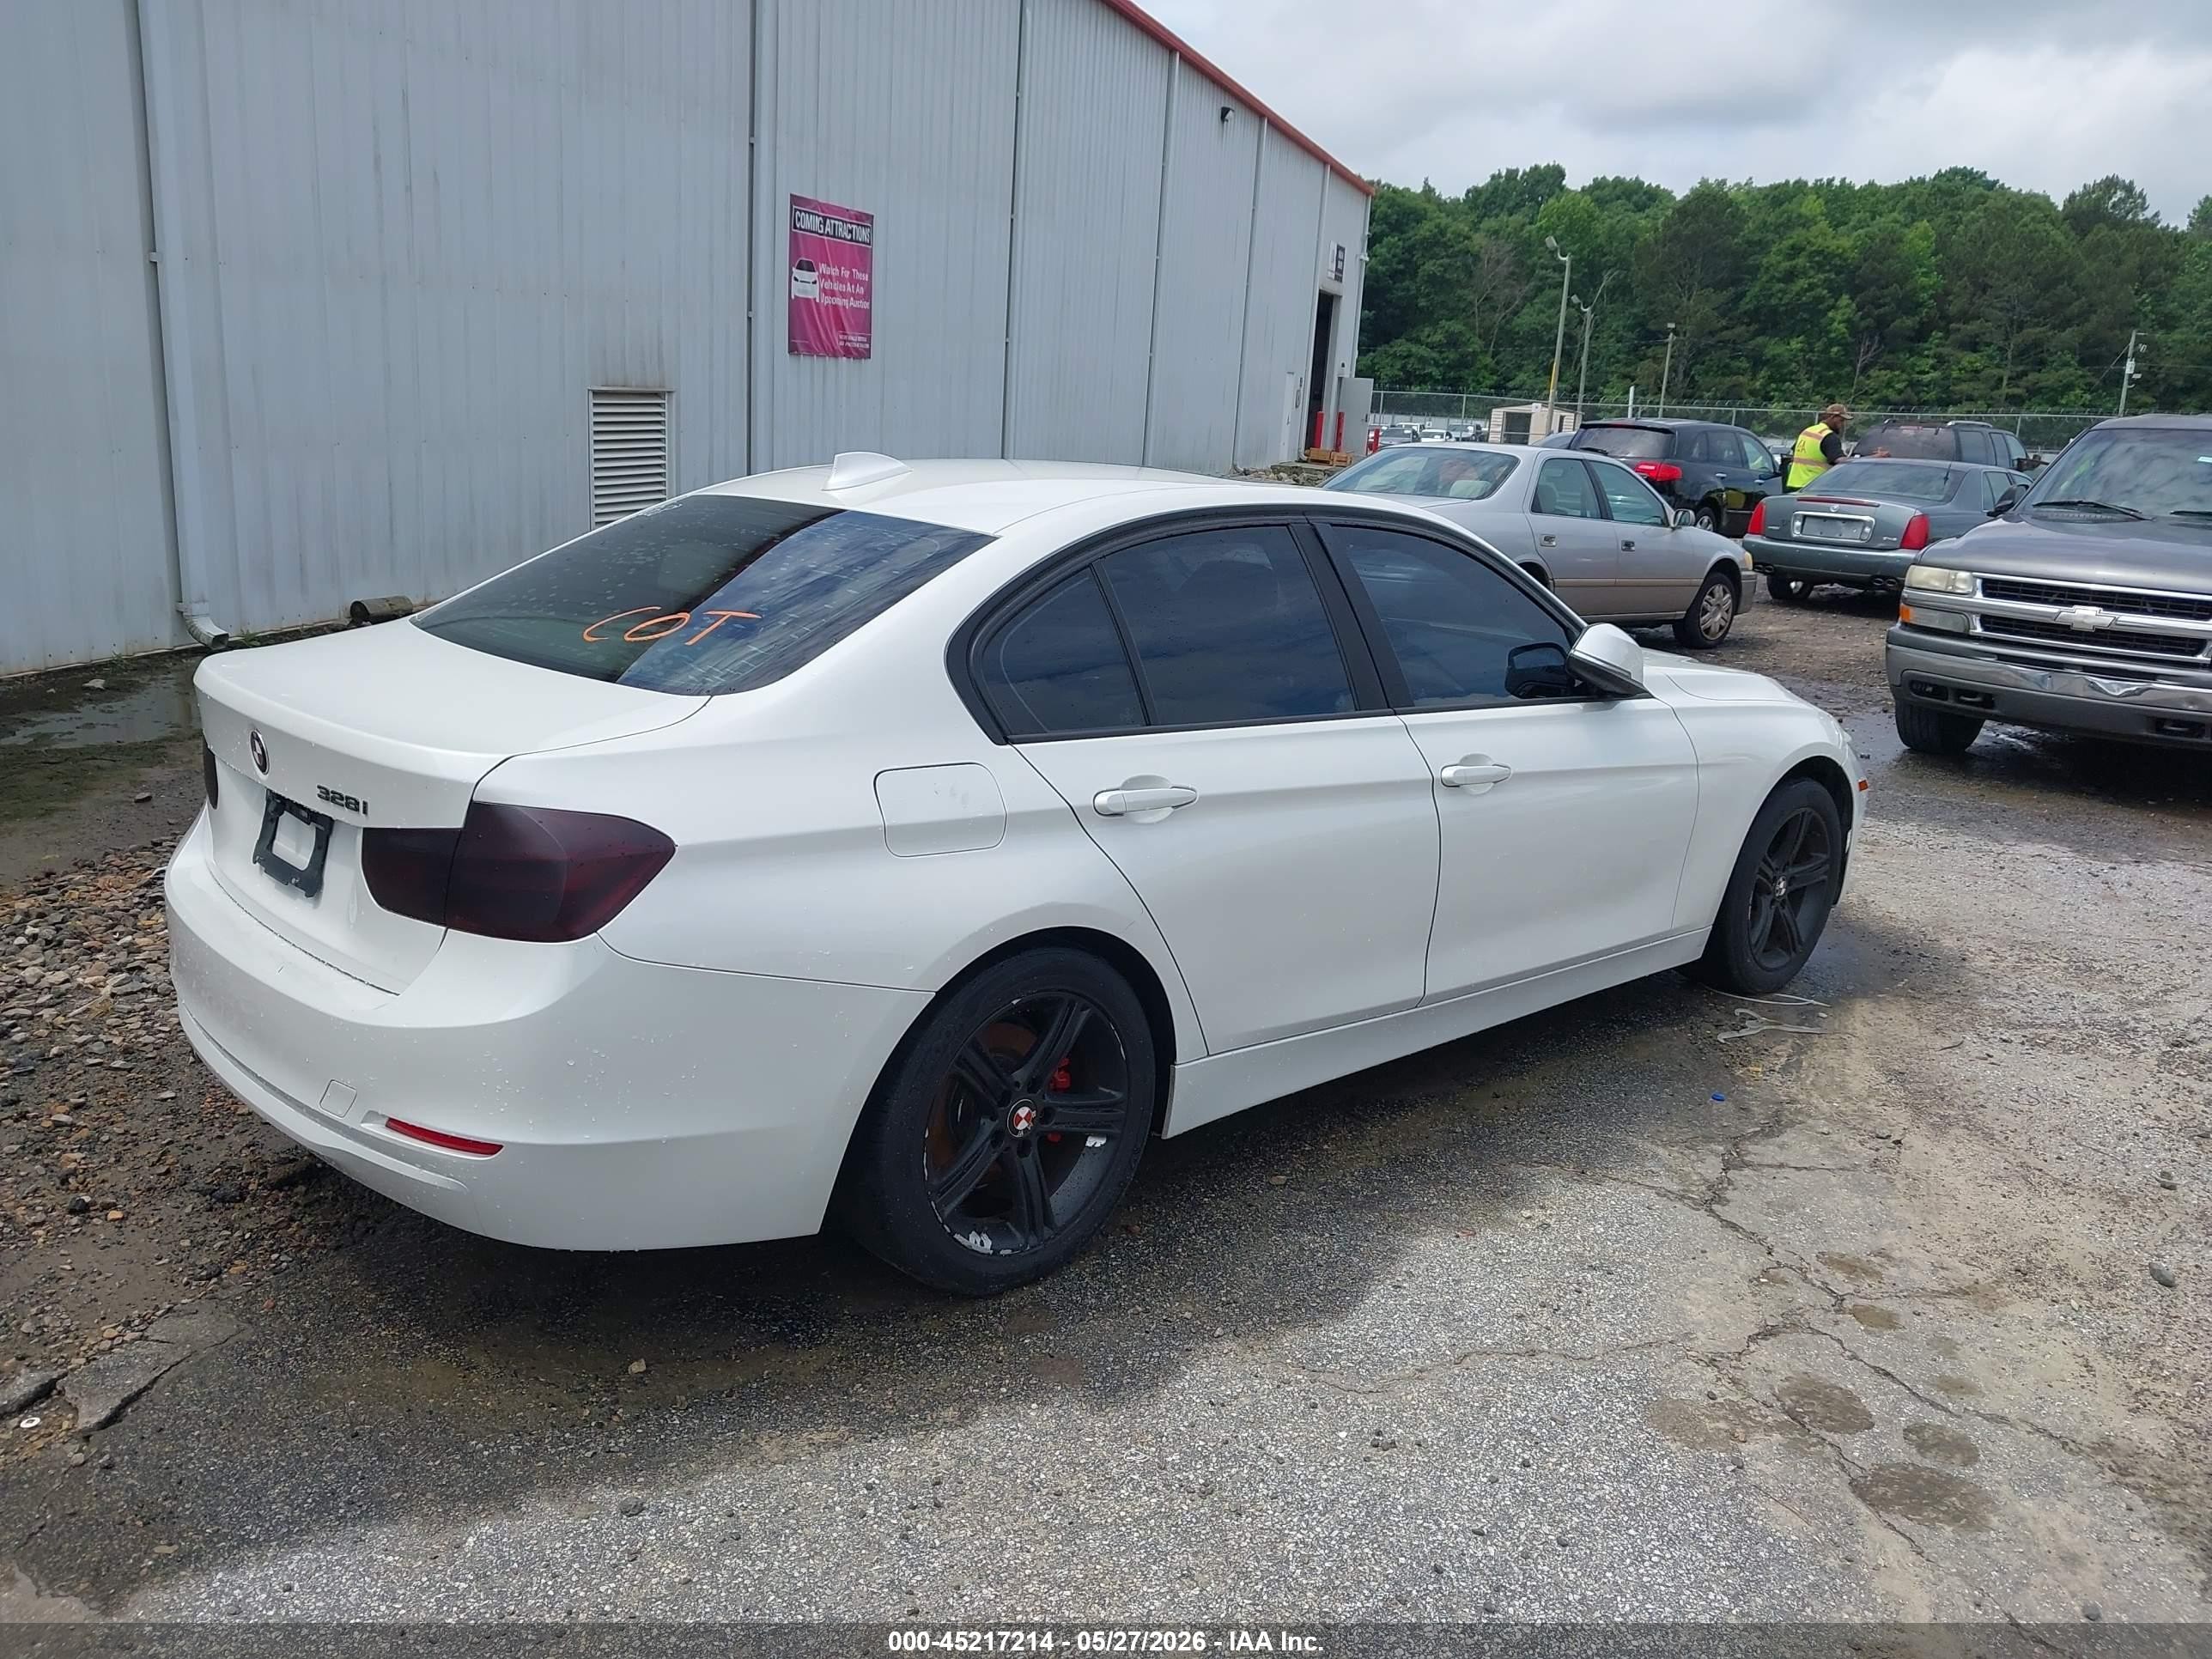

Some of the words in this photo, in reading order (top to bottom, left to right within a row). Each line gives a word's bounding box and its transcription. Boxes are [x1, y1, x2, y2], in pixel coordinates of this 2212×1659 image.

[824, 218, 871, 244] ATTRACTIONS
[818, 262, 840, 276] Watch
[841, 266, 850, 278] For
[852, 268, 869, 282] These
[819, 276, 846, 292] Vehicles
[847, 282, 855, 295] At
[855, 283, 864, 295] An
[820, 292, 848, 309] Upcoming
[583, 606, 763, 646] COT
